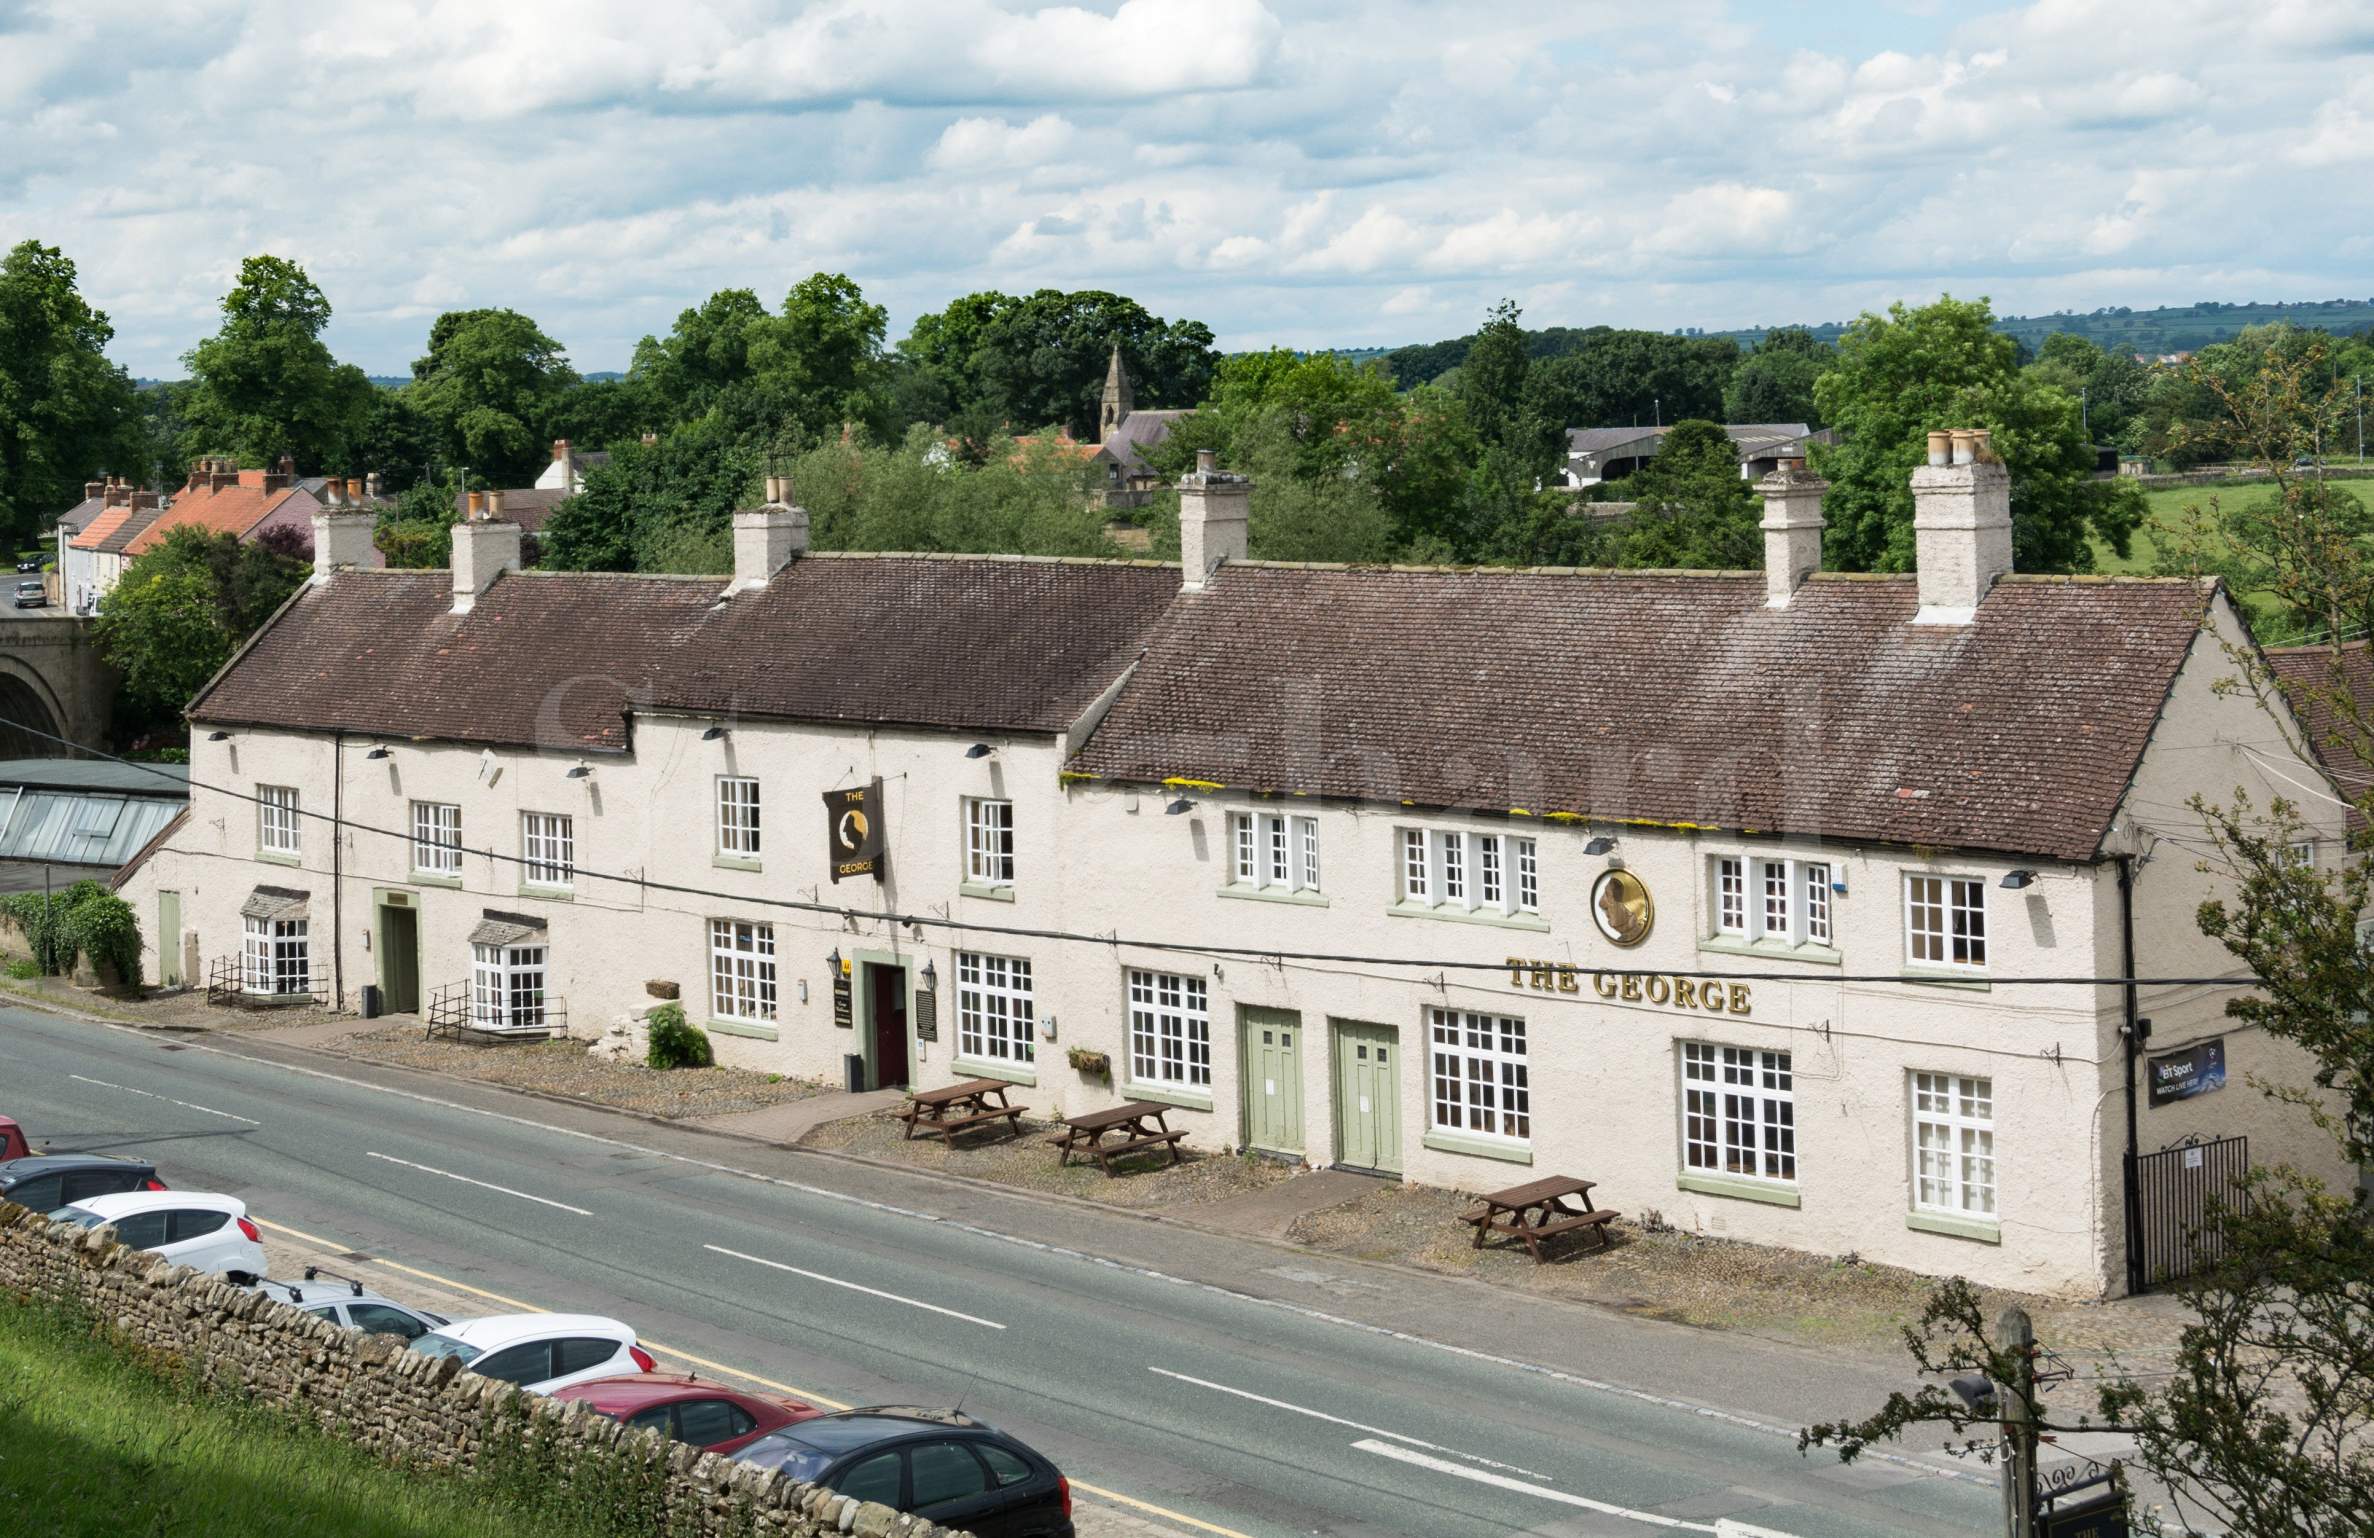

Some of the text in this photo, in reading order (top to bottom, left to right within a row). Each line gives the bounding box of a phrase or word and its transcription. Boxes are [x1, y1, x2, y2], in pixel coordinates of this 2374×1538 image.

[845, 791, 864, 802] THE
[839, 861, 873, 874] GEORGE
[1505, 956, 1752, 1015] THE GEORGE
[2163, 1067, 2173, 1080] BT
[2173, 1061, 2193, 1078] Sport
[2157, 1084, 2176, 1095] WATCH
